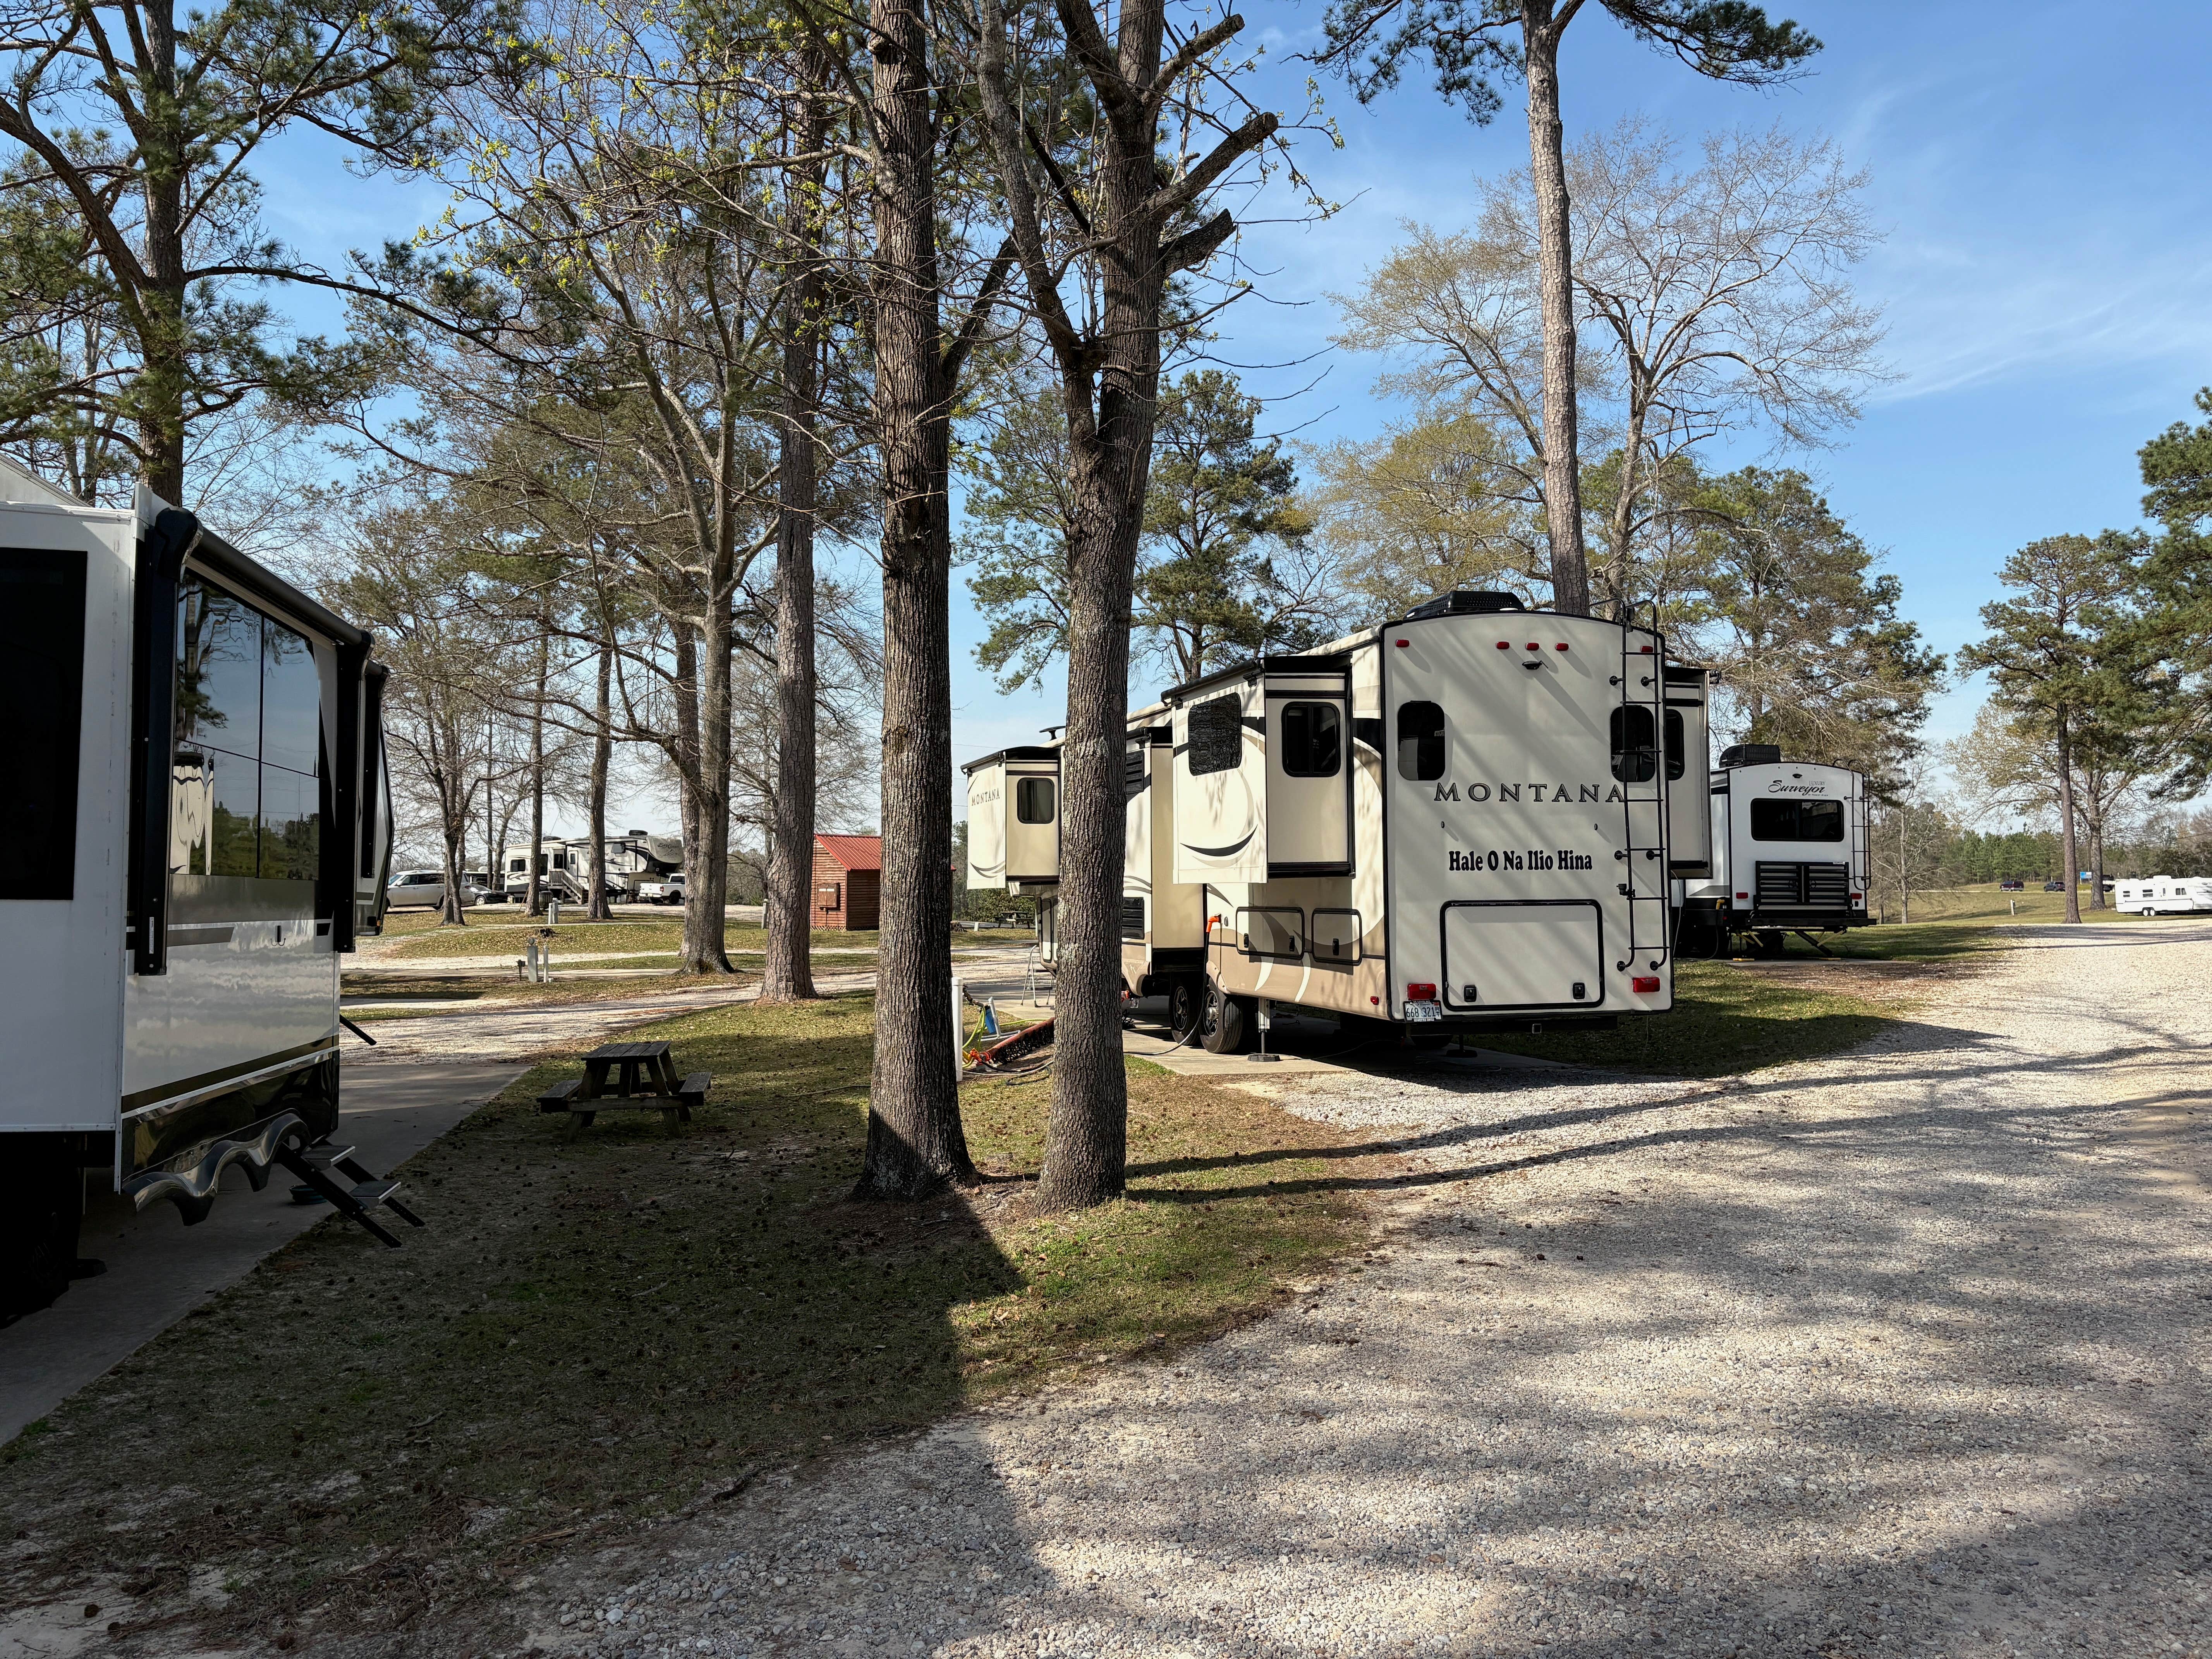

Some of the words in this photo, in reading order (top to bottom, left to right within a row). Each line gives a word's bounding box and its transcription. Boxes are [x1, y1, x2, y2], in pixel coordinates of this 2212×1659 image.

[972, 787, 1000, 806] MONTANA
[1434, 782, 1625, 802] MONTANA
[1768, 780, 1825, 796] Surveyor
[1449, 851, 1483, 871] Hale
[1487, 850, 1499, 871] O
[1503, 850, 1523, 870] Na
[1528, 850, 1553, 870] Ilio
[1558, 850, 1592, 870] Hina
[1406, 1007, 1419, 1017] 668
[1422, 1007, 1436, 1017] 321
